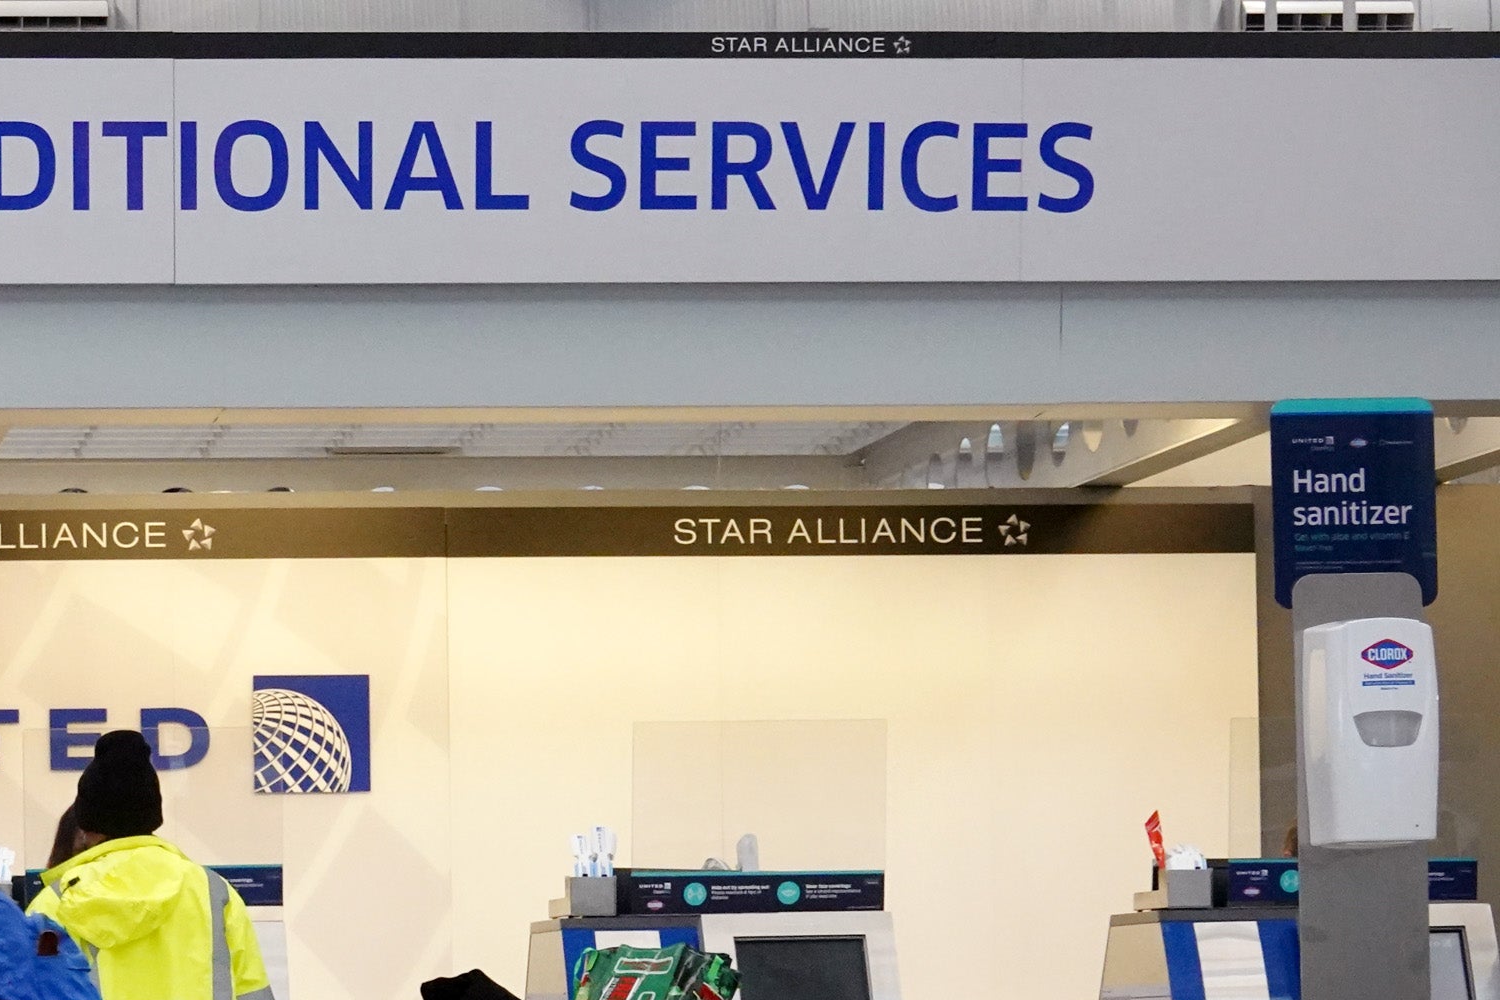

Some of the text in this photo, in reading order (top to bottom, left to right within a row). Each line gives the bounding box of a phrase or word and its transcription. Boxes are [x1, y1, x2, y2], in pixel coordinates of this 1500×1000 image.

[711, 37, 885, 53] STAR ALLIANCE
[570, 120, 1094, 213] SERVICES
[1293, 468, 1366, 494] Hand
[1293, 500, 1413, 526] sanitizer
[674, 516, 984, 546] STAR ALLIANCE
[1367, 648, 1408, 660] CLOROX
